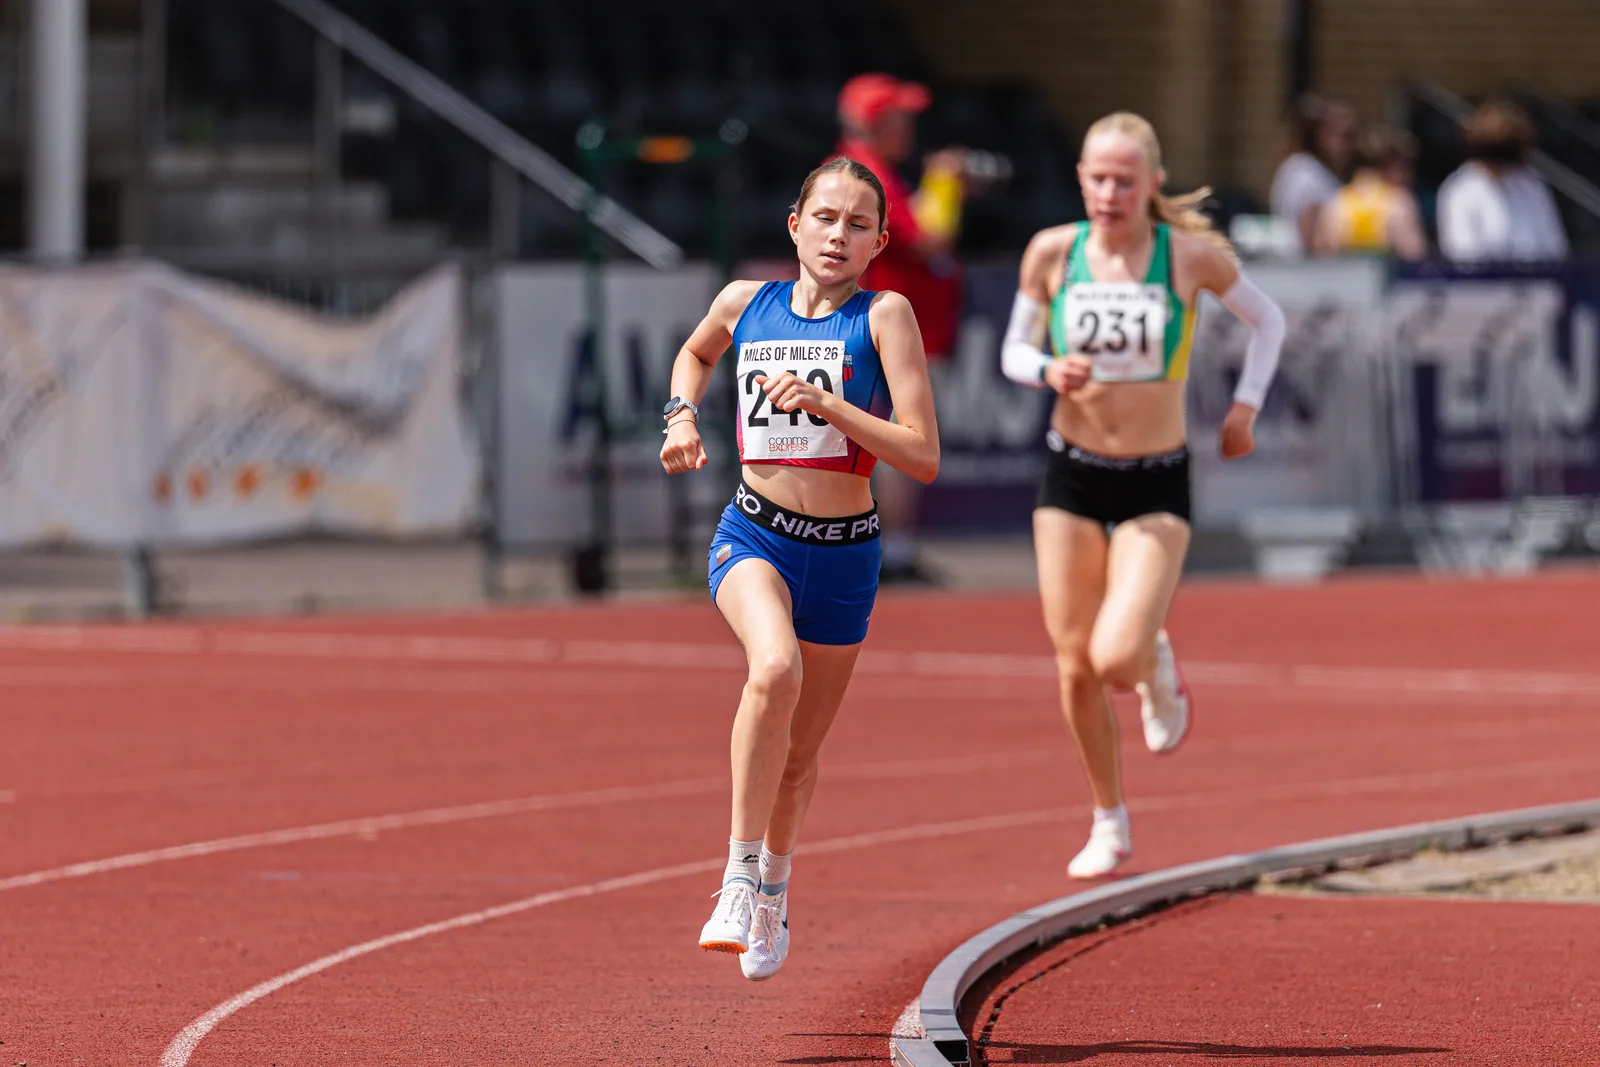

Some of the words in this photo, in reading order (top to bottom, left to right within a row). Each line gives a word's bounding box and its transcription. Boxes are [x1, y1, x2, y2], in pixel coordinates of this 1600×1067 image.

[1078, 310, 1149, 355] 231
[744, 347, 772, 362] MILES
[774, 347, 787, 360] OF
[789, 346, 821, 361] MILES
[824, 346, 838, 360] 26
[768, 437, 808, 445] comms
[768, 443, 808, 452] express
[771, 511, 846, 541] NIKE
